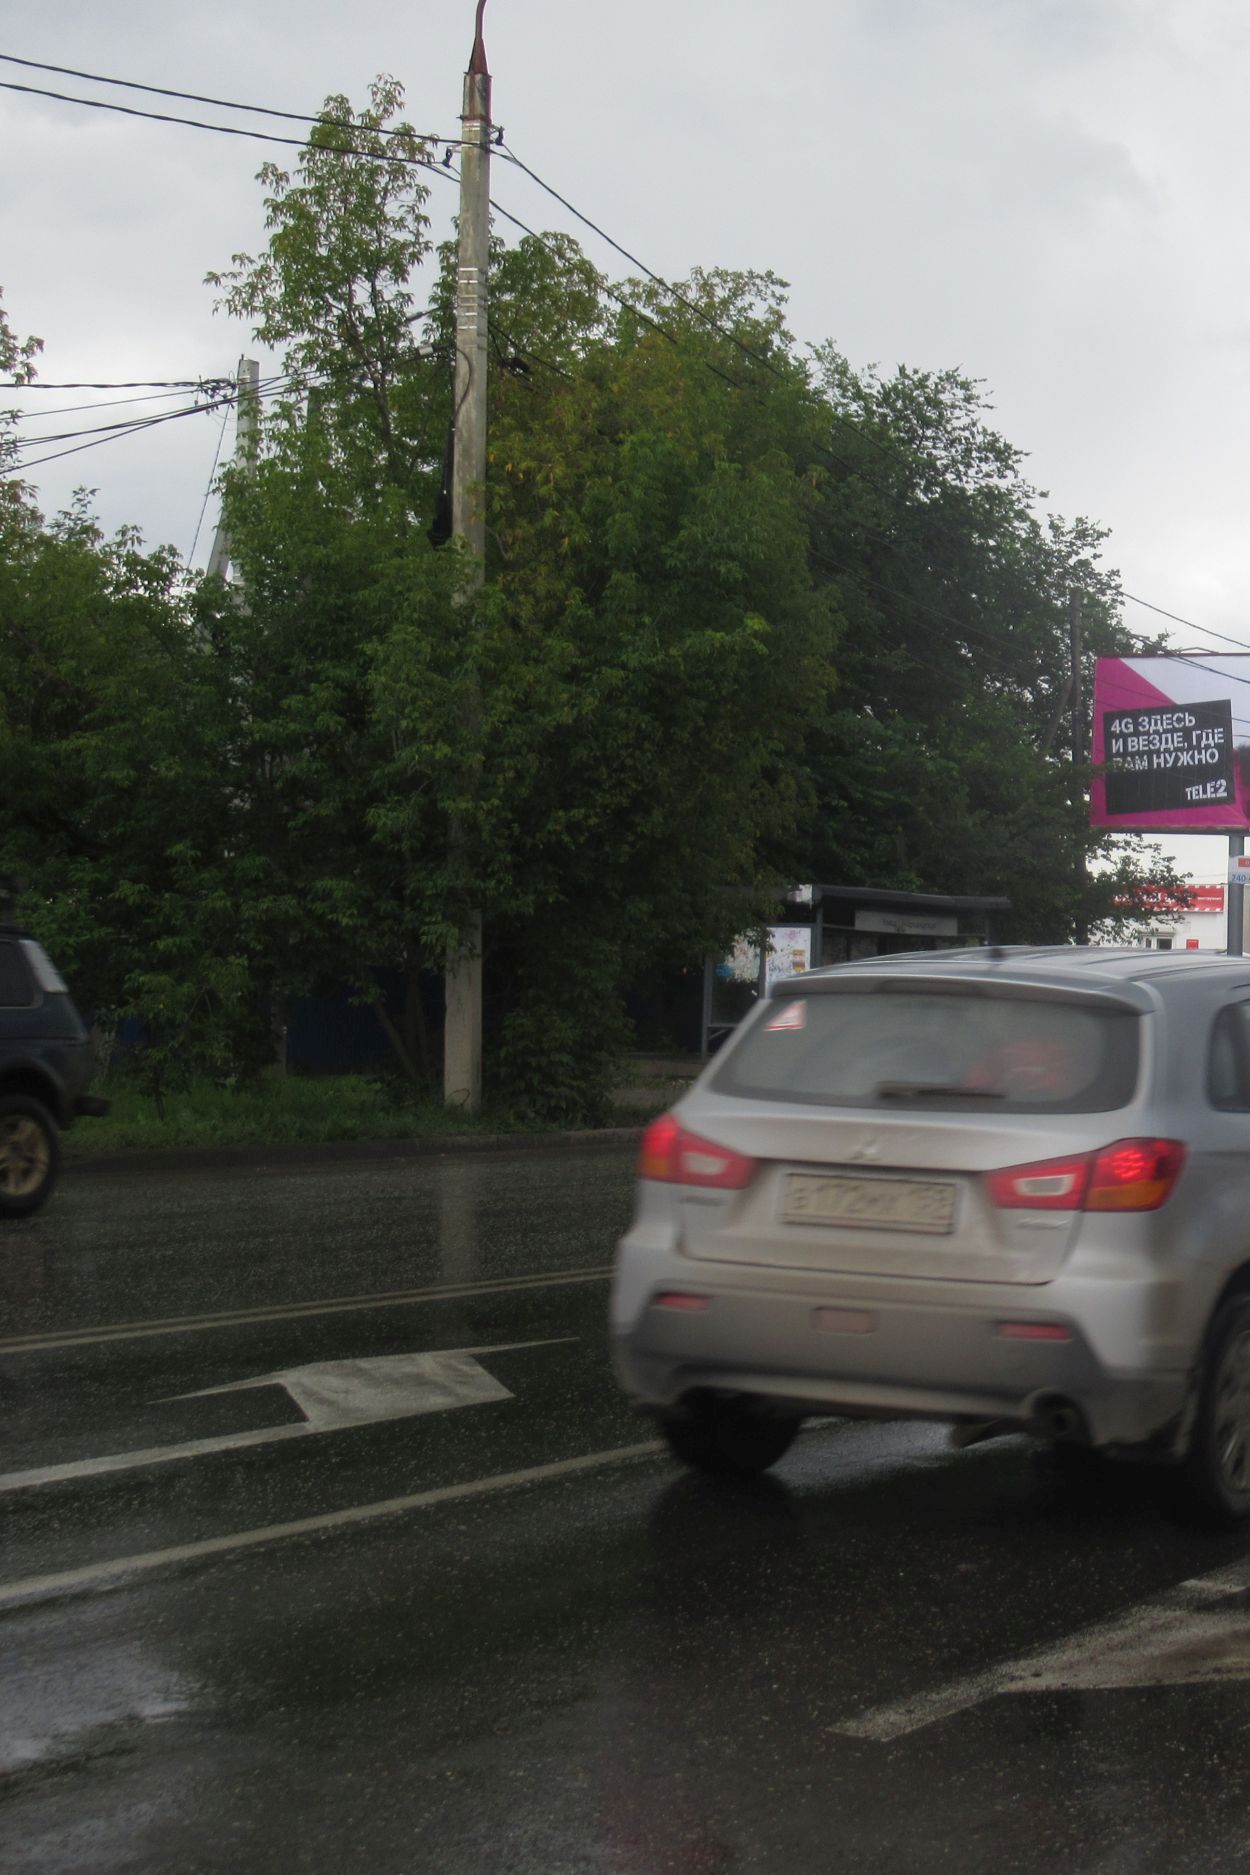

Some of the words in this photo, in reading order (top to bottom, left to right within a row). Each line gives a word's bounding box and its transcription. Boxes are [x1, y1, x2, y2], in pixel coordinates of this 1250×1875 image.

[1111, 718, 1134, 734] 4G
[1138, 712, 1195, 733] ЗДЕСЬ
[1112, 738, 1123, 753] И
[1128, 732, 1188, 752] ВЕЗДЕ,
[1192, 728, 1224, 748] ГДЕ
[1153, 748, 1219, 769] НУЖНО
[1185, 779, 1228, 800] TELE2
